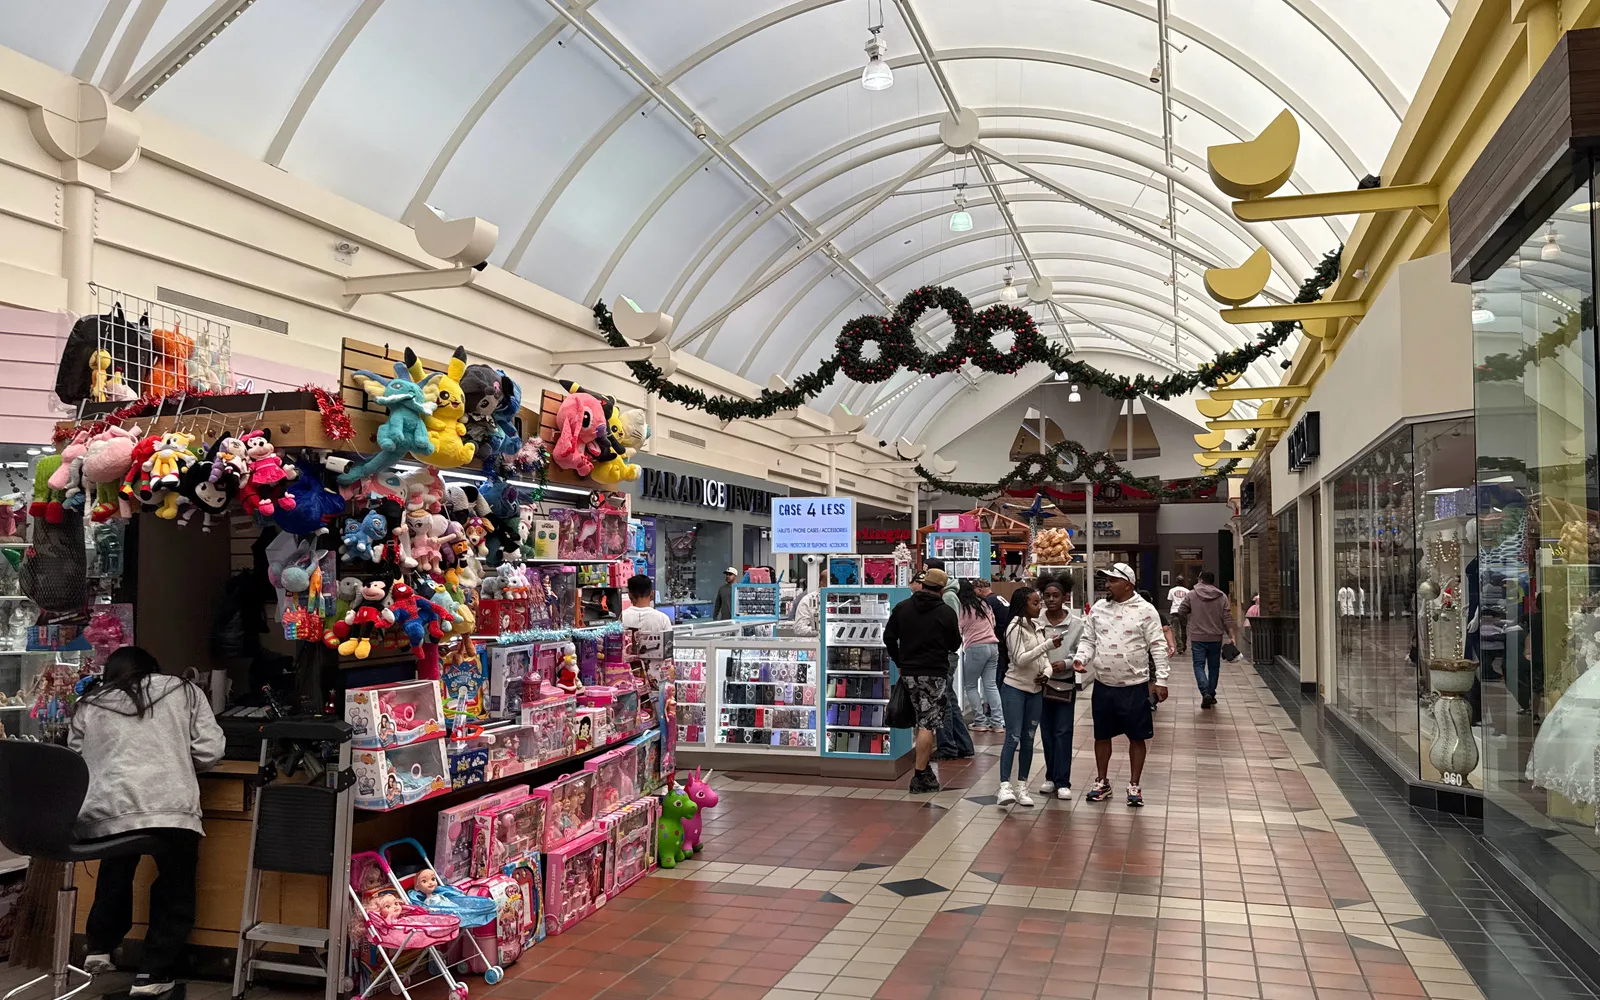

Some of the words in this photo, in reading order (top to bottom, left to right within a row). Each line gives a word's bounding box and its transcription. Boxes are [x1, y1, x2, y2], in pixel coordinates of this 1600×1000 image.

[642, 467, 725, 508] PARADICE
[779, 503, 802, 516] CASE
[807, 502, 816, 517] 4
[821, 503, 846, 516] LESS
[1443, 771, 1462, 786] 960
